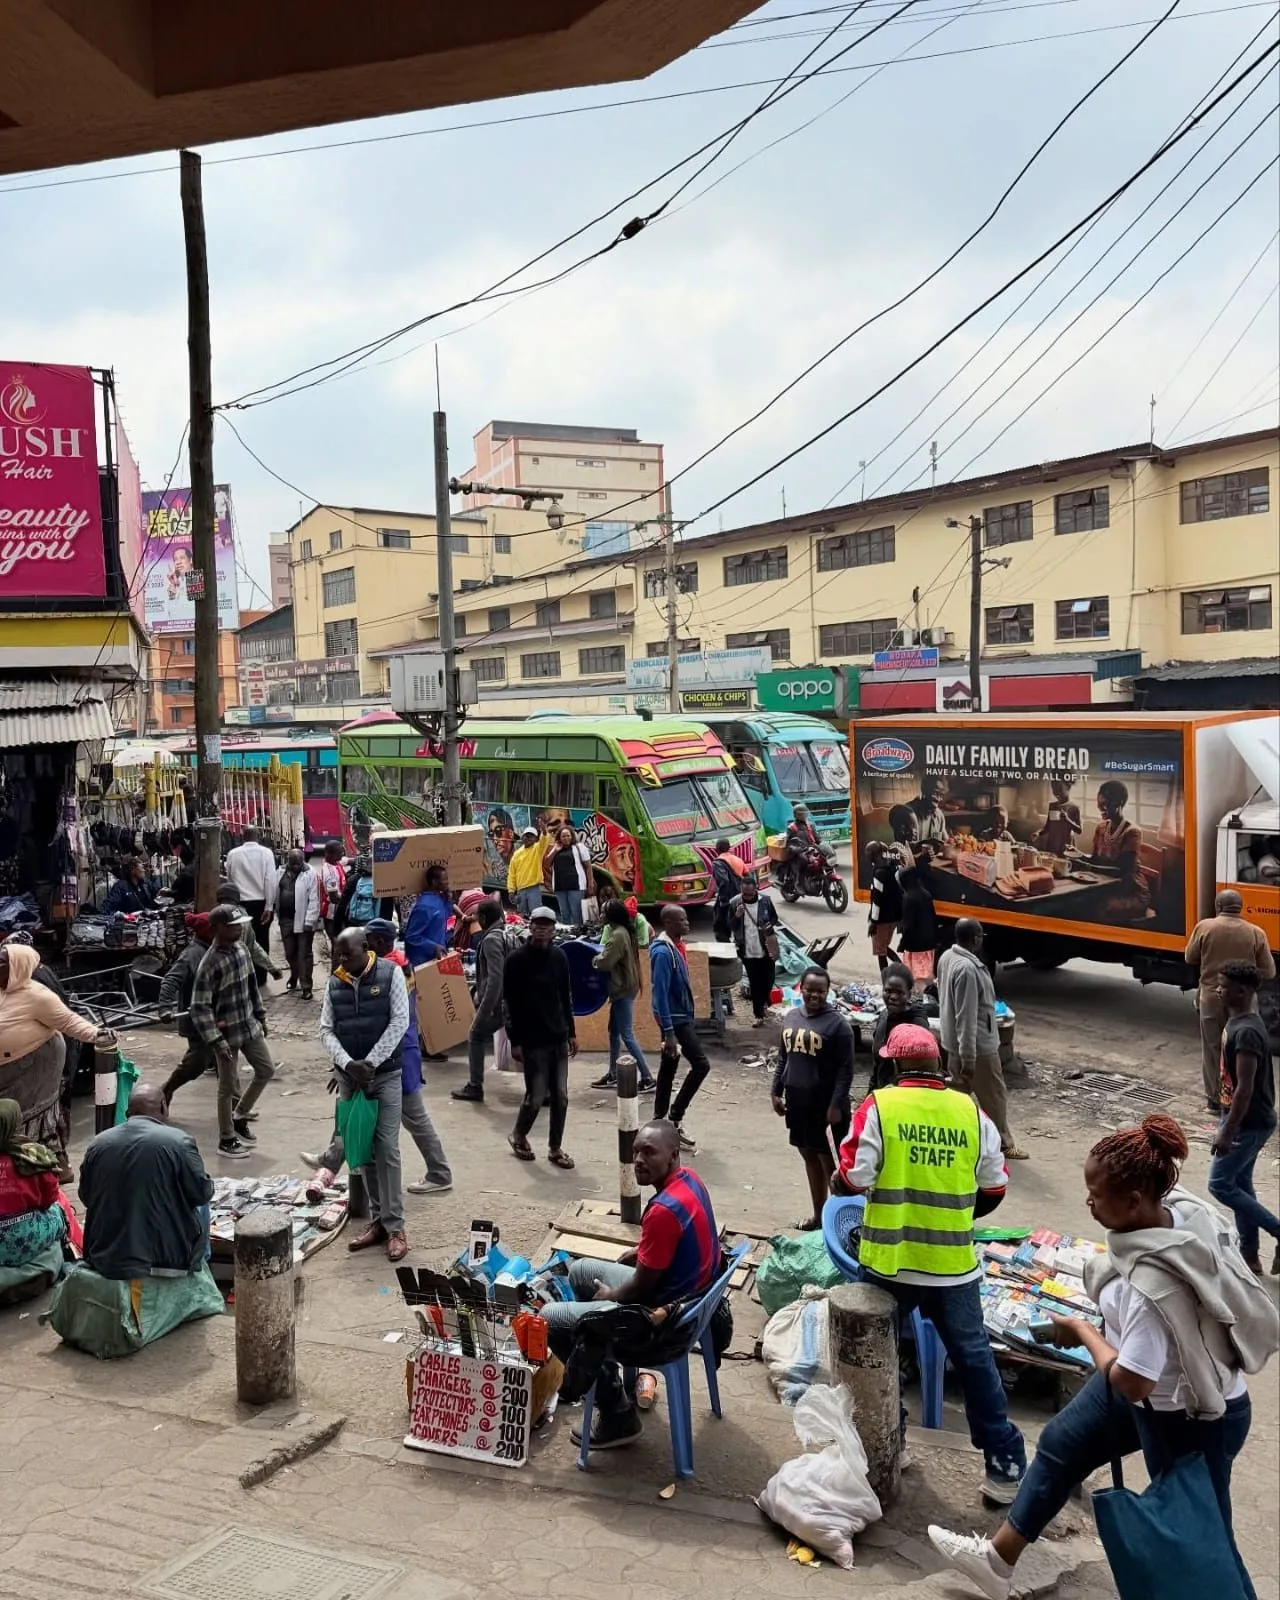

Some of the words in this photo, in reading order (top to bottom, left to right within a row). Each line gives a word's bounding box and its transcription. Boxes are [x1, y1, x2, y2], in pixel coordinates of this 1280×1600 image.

[1, 459, 54, 480] Hair
[28, 526, 62, 540] with
[0, 541, 75, 575] you
[684, 692, 716, 702] CHICKEN
[717, 692, 722, 701] &
[723, 691, 746, 701] CHIPS
[777, 680, 833, 701] oppo
[925, 744, 966, 766] DAILY
[970, 745, 1029, 768] FAMILY
[1034, 746, 1090, 770] BREAD
[1104, 761, 1175, 772] #BeSugarSmart
[868, 770, 888, 778] heritage
[926, 768, 949, 776] HAVE
[960, 769, 984, 778] SLICE
[985, 770, 999, 778] OR
[1001, 771, 1024, 781] TWO,
[1026, 772, 1039, 780] OR
[1042, 773, 1061, 781] ALL
[1063, 773, 1077, 782] OF
[1080, 774, 1089, 782] IT
[409, 858, 449, 869] VITRON
[882, 850, 900, 860] aked
[440, 982, 458, 1024] VITRON
[782, 1028, 823, 1057] GAP
[898, 1124, 968, 1149] NAEKANA
[909, 1146, 955, 1168] STAFF
[419, 1351, 460, 1375] CABLES
[483, 1364, 501, 1381] @
[501, 1366, 526, 1387] 100
[418, 1369, 471, 1396] CHARGERS
[481, 1382, 502, 1400] @
[502, 1386, 528, 1408] 200
[416, 1387, 477, 1416] PROTECTORS
[482, 1400, 500, 1417] @
[500, 1406, 526, 1426] 100
[412, 1423, 458, 1448] COVERS
[476, 1435, 491, 1451] @
[493, 1440, 526, 1461] 200
[479, 1417, 496, 1432] @
[498, 1424, 526, 1445] 100
